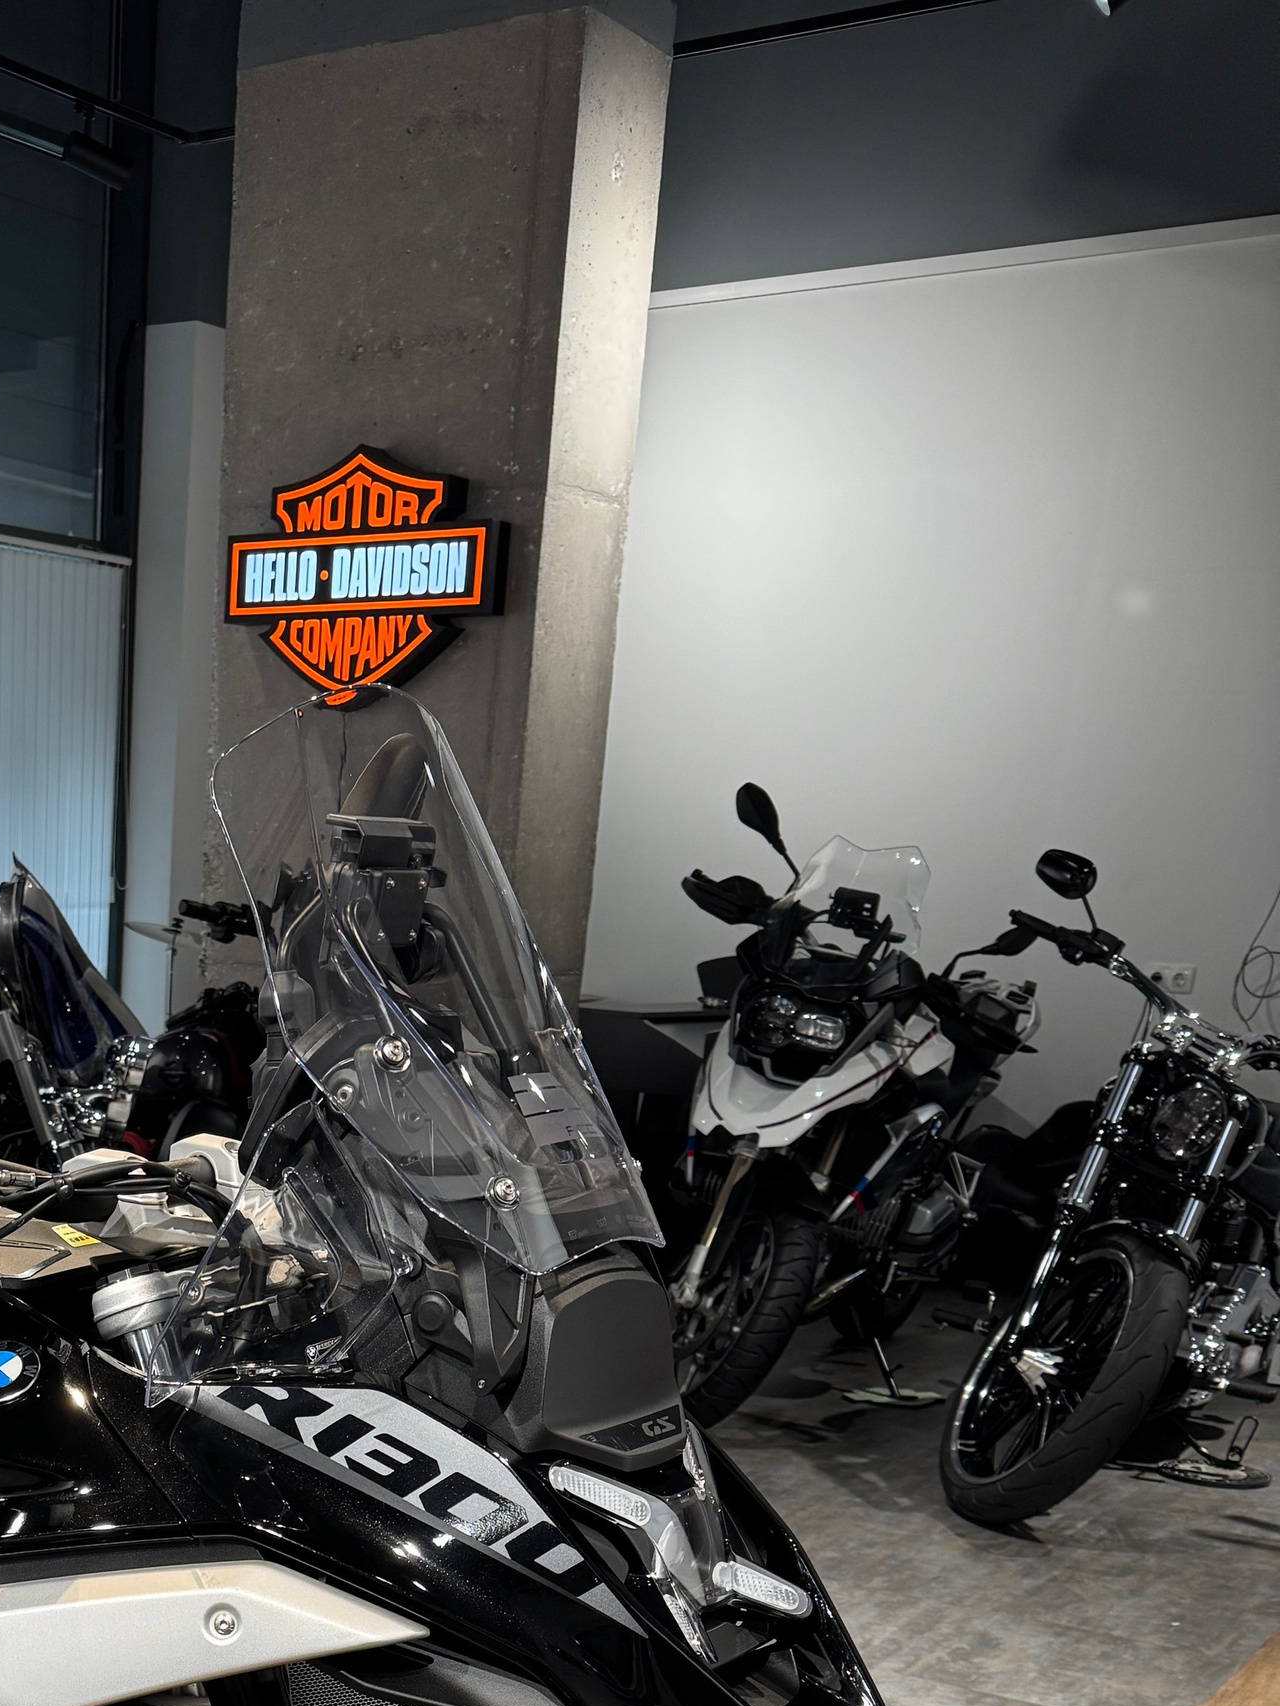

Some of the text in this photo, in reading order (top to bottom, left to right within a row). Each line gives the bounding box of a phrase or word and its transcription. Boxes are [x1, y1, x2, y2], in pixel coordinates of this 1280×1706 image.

[297, 471, 419, 532] MOTOR
[244, 541, 468, 603] HELLO DAVIDSON
[289, 614, 413, 682] COMPANY
[641, 1415, 677, 1437] GS
